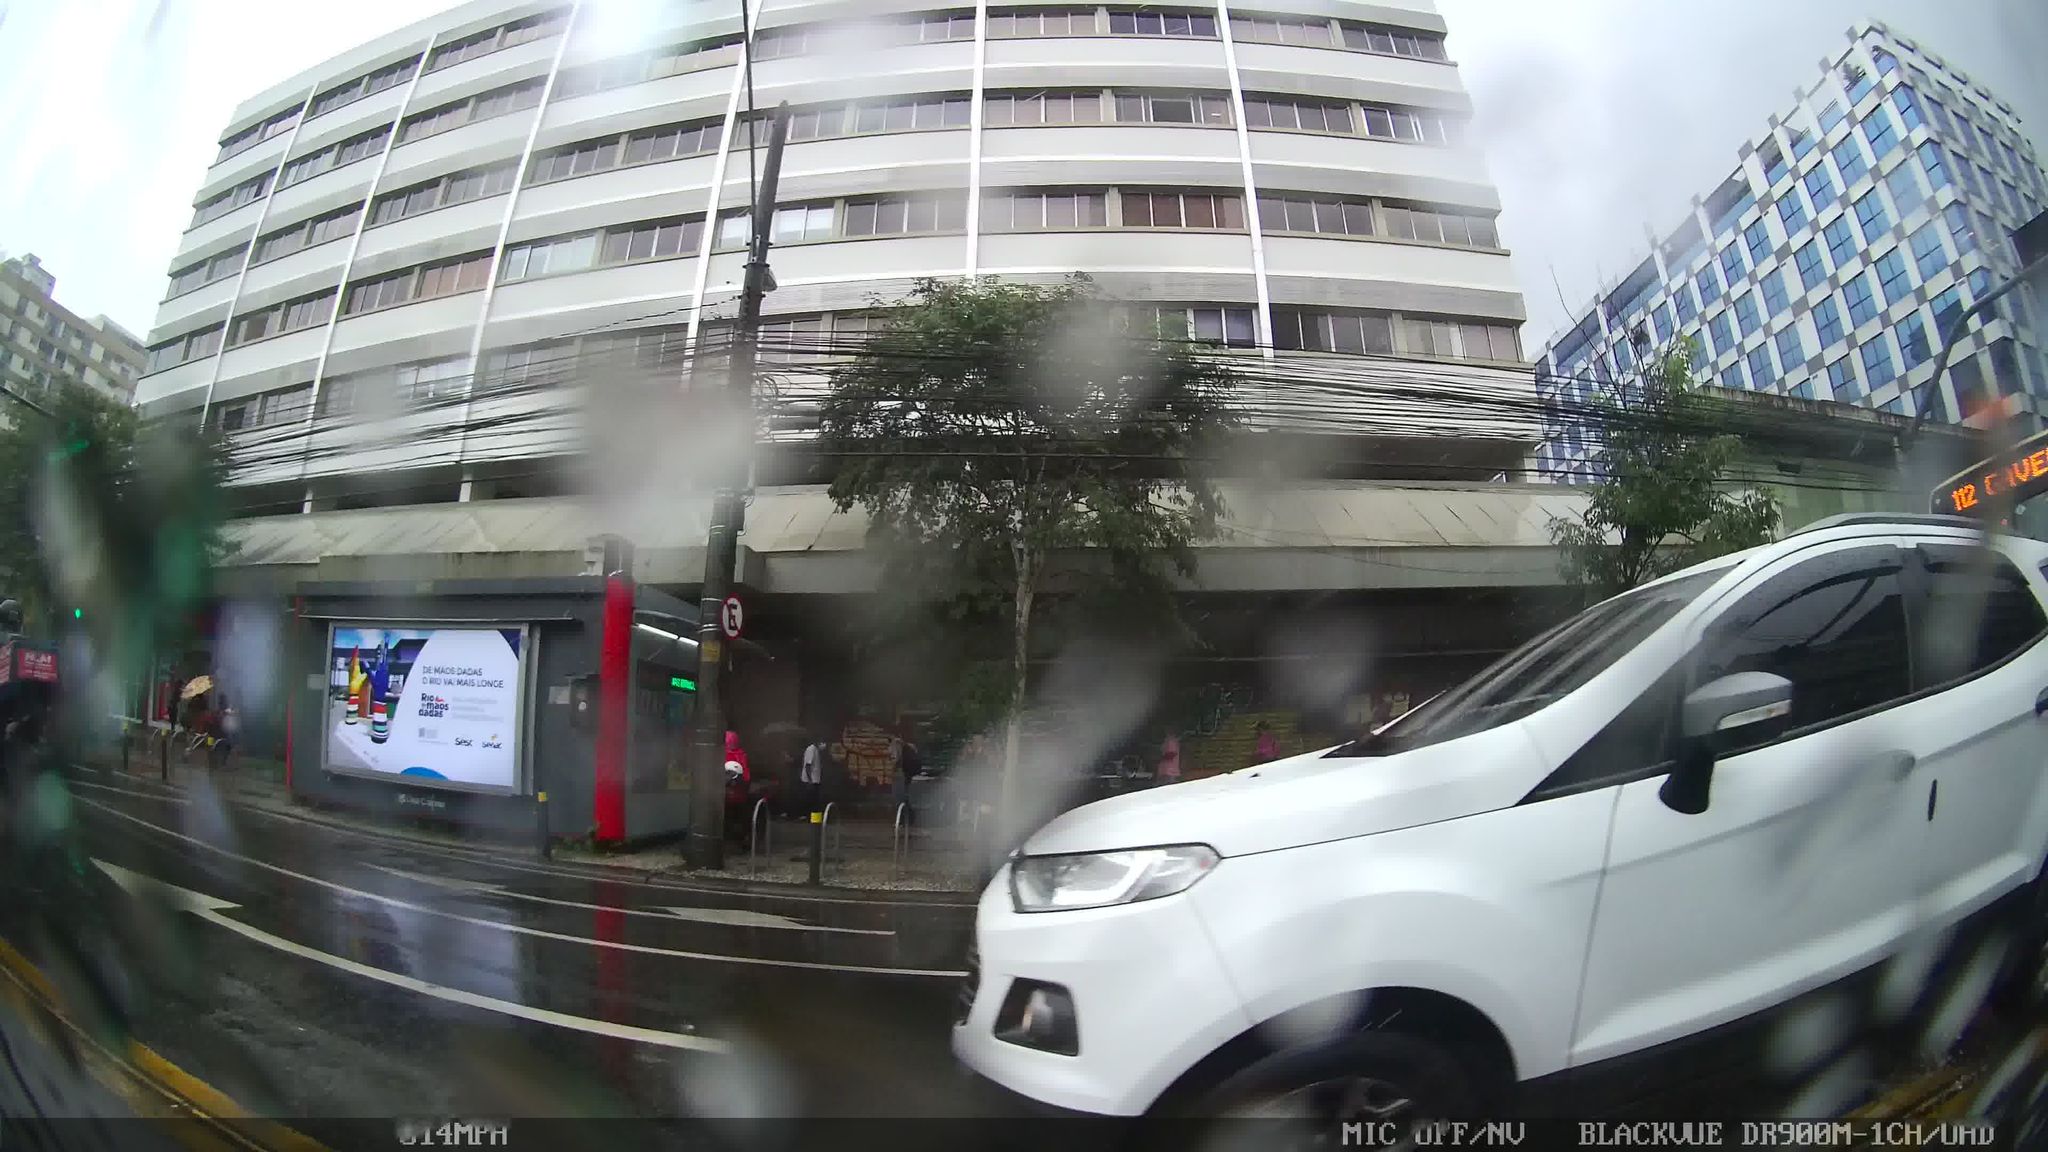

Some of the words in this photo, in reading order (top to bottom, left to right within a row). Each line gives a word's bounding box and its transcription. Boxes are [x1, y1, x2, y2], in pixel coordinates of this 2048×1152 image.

[422, 665, 432, 674] DE
[457, 667, 483, 676] DADAS
[456, 678, 476, 687] MAIS
[477, 679, 504, 688] LONGE
